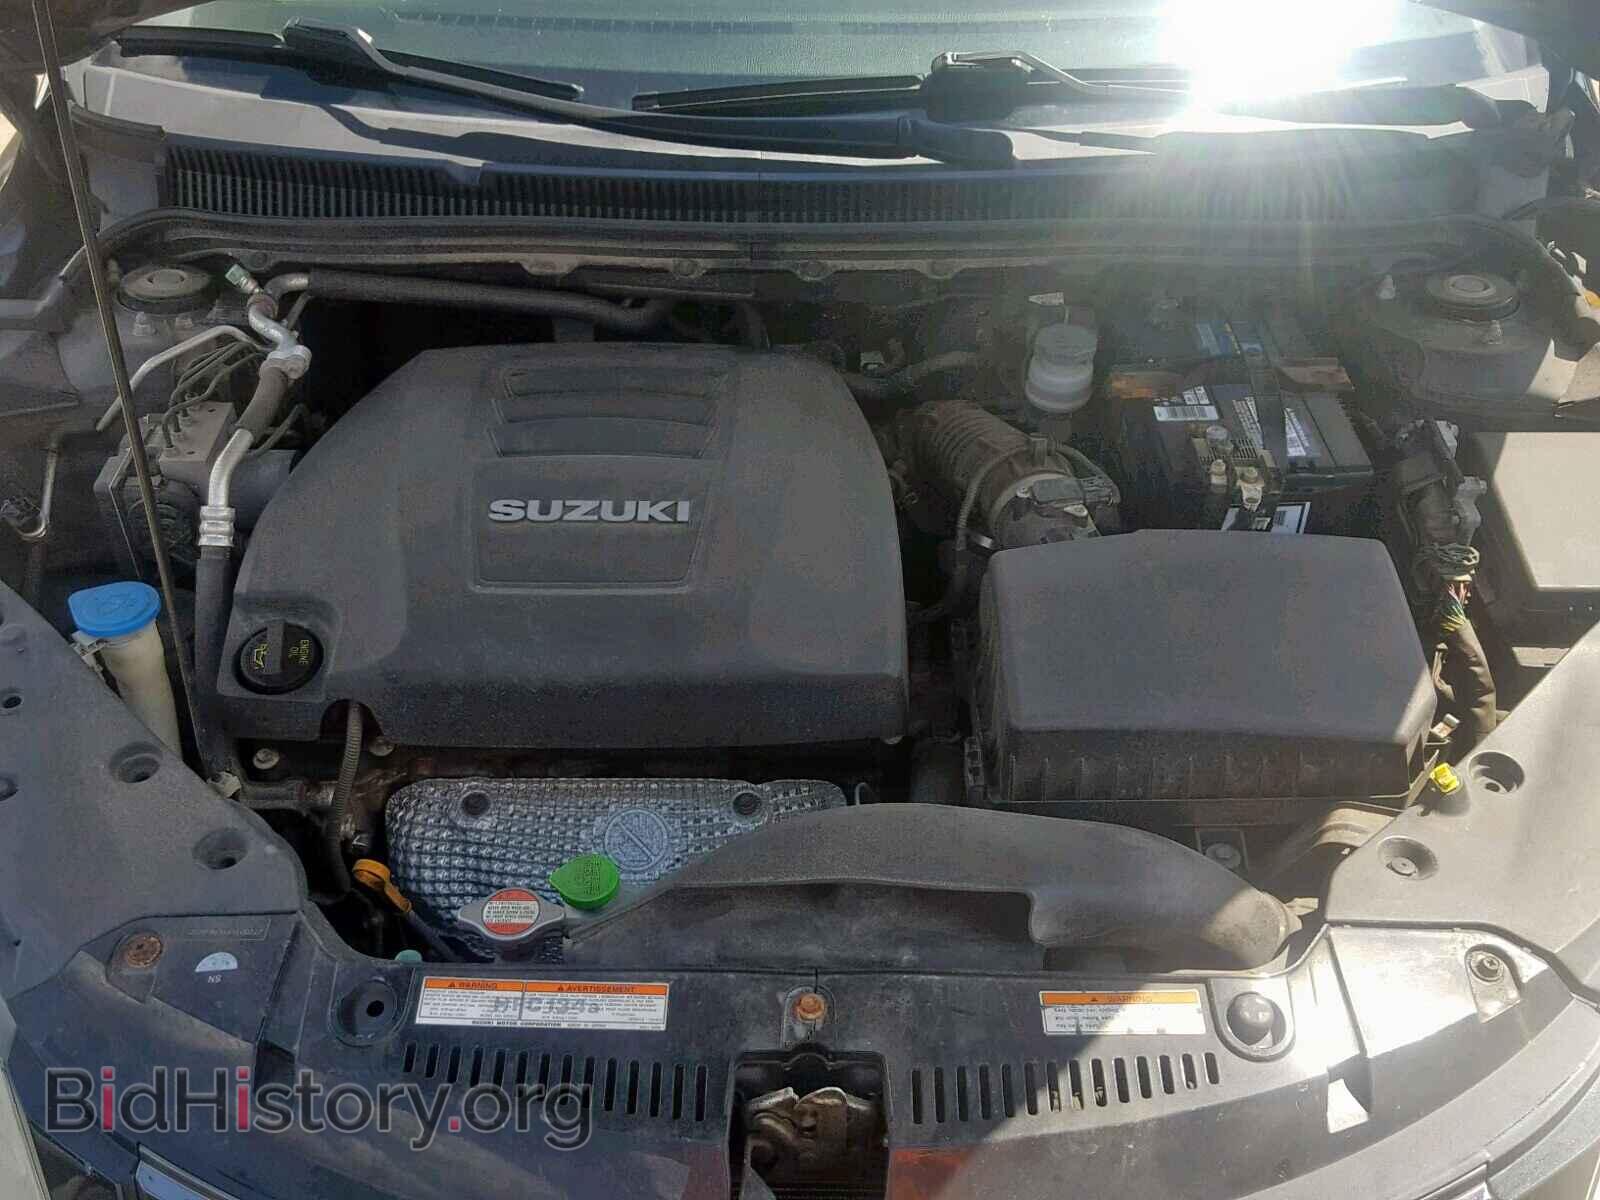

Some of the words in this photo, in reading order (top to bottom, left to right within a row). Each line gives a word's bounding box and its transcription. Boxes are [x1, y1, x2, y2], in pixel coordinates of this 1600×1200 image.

[488, 499, 691, 522] SUZUKI
[289, 647, 299, 659] OIL
[299, 639, 310, 665] ENGINE
[459, 981, 497, 991] WARNING
[566, 983, 635, 993] AVERTISSEMENT
